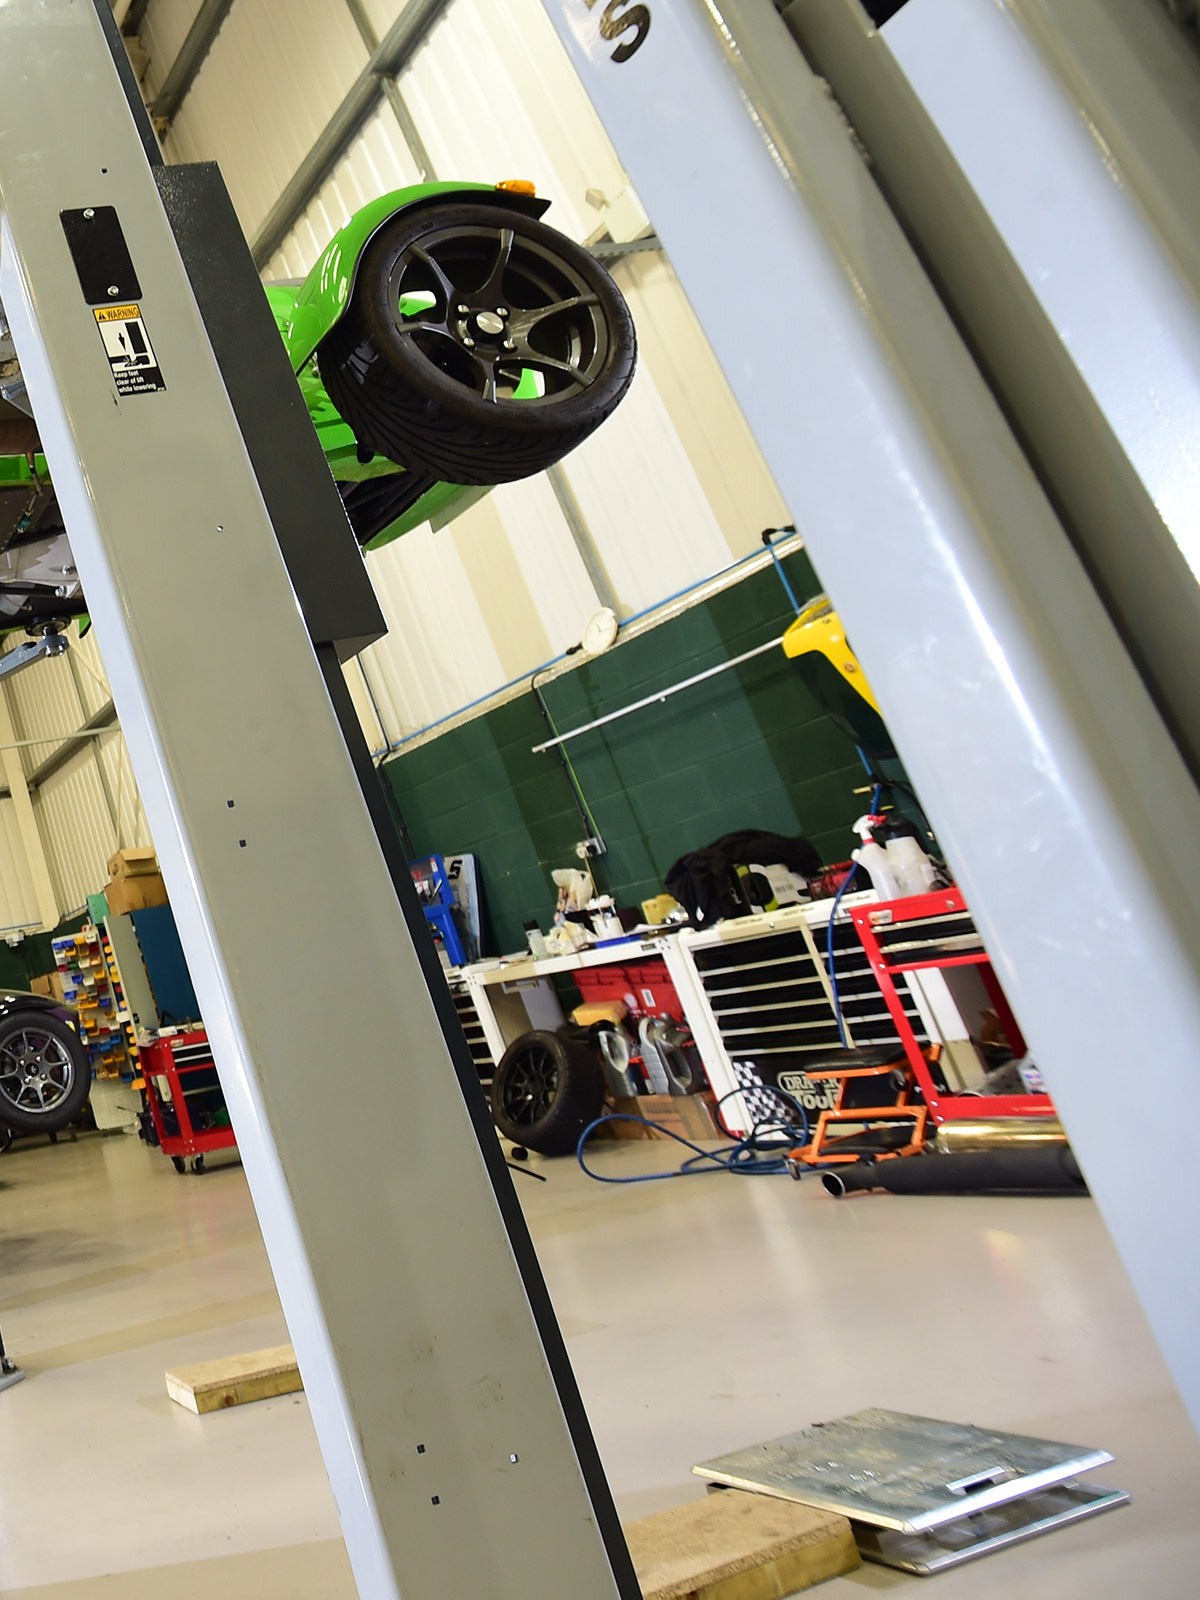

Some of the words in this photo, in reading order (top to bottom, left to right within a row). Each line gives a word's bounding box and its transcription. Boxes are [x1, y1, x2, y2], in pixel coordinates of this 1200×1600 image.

[106, 307, 140, 319] WARNING
[116, 378, 130, 386] clear
[119, 385, 133, 393] while
[133, 383, 156, 391] lowering
[783, 1075, 840, 1090] DRAR
